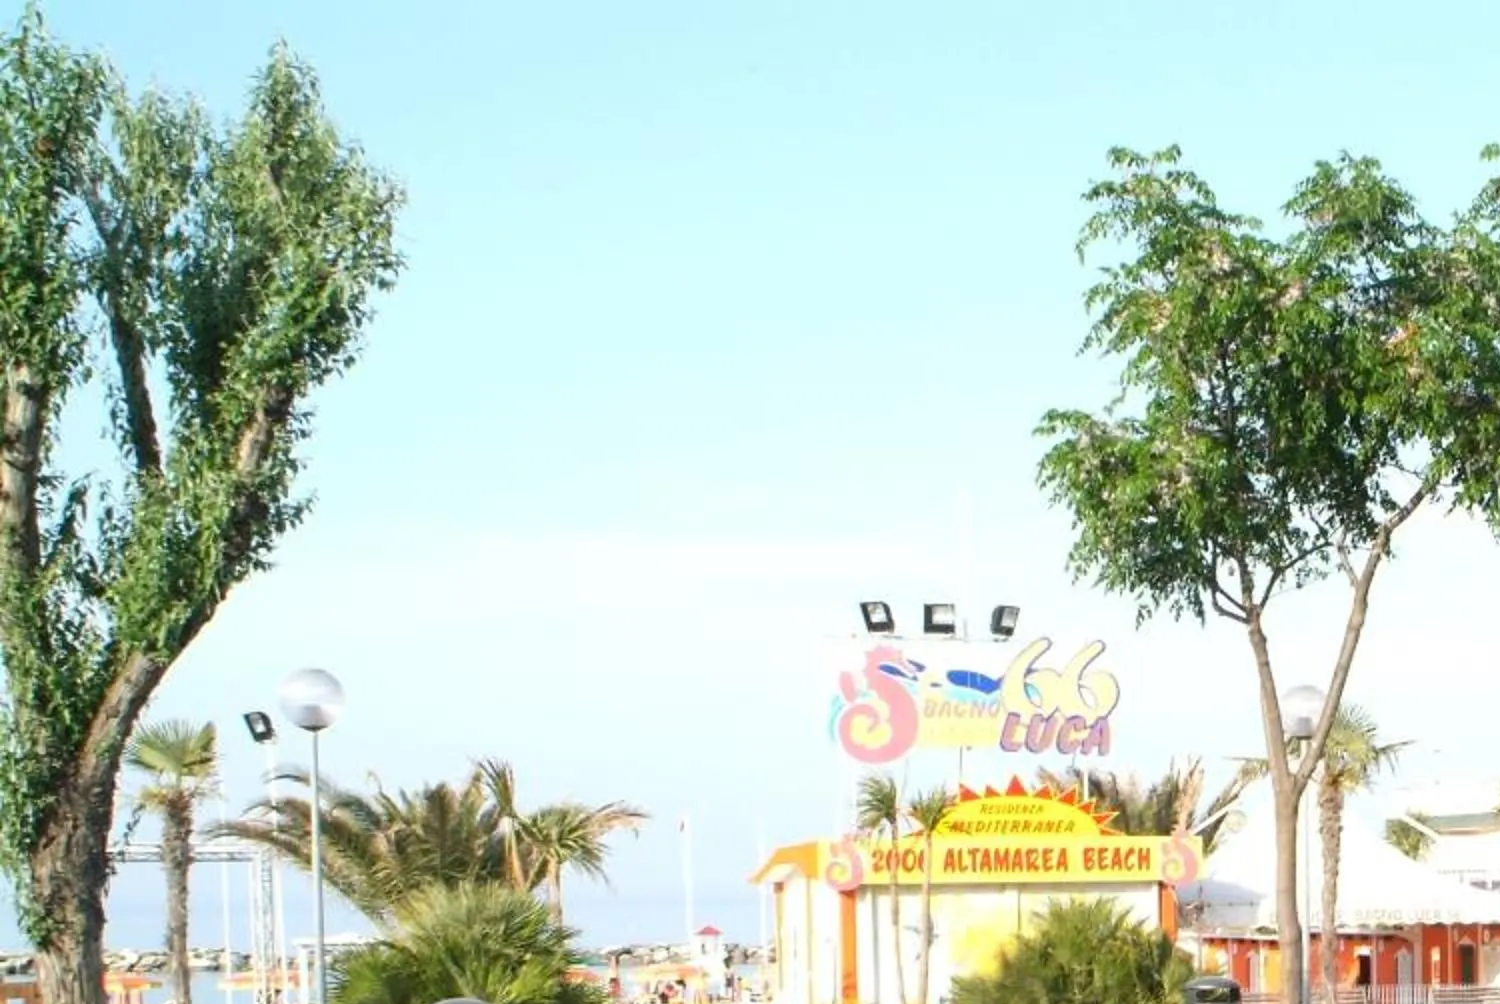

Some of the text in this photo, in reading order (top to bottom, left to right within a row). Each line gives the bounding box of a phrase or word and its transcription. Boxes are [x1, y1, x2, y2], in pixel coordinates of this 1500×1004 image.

[1001, 636, 1121, 718] 66
[924, 696, 1001, 719] BAGNO
[1000, 711, 1112, 757] LUCA
[979, 803, 1044, 815] RESIDENZA
[949, 819, 1076, 834] MEDITERRANEA
[943, 847, 1069, 873] ALTAMAREA
[1083, 846, 1151, 872] BEACH
